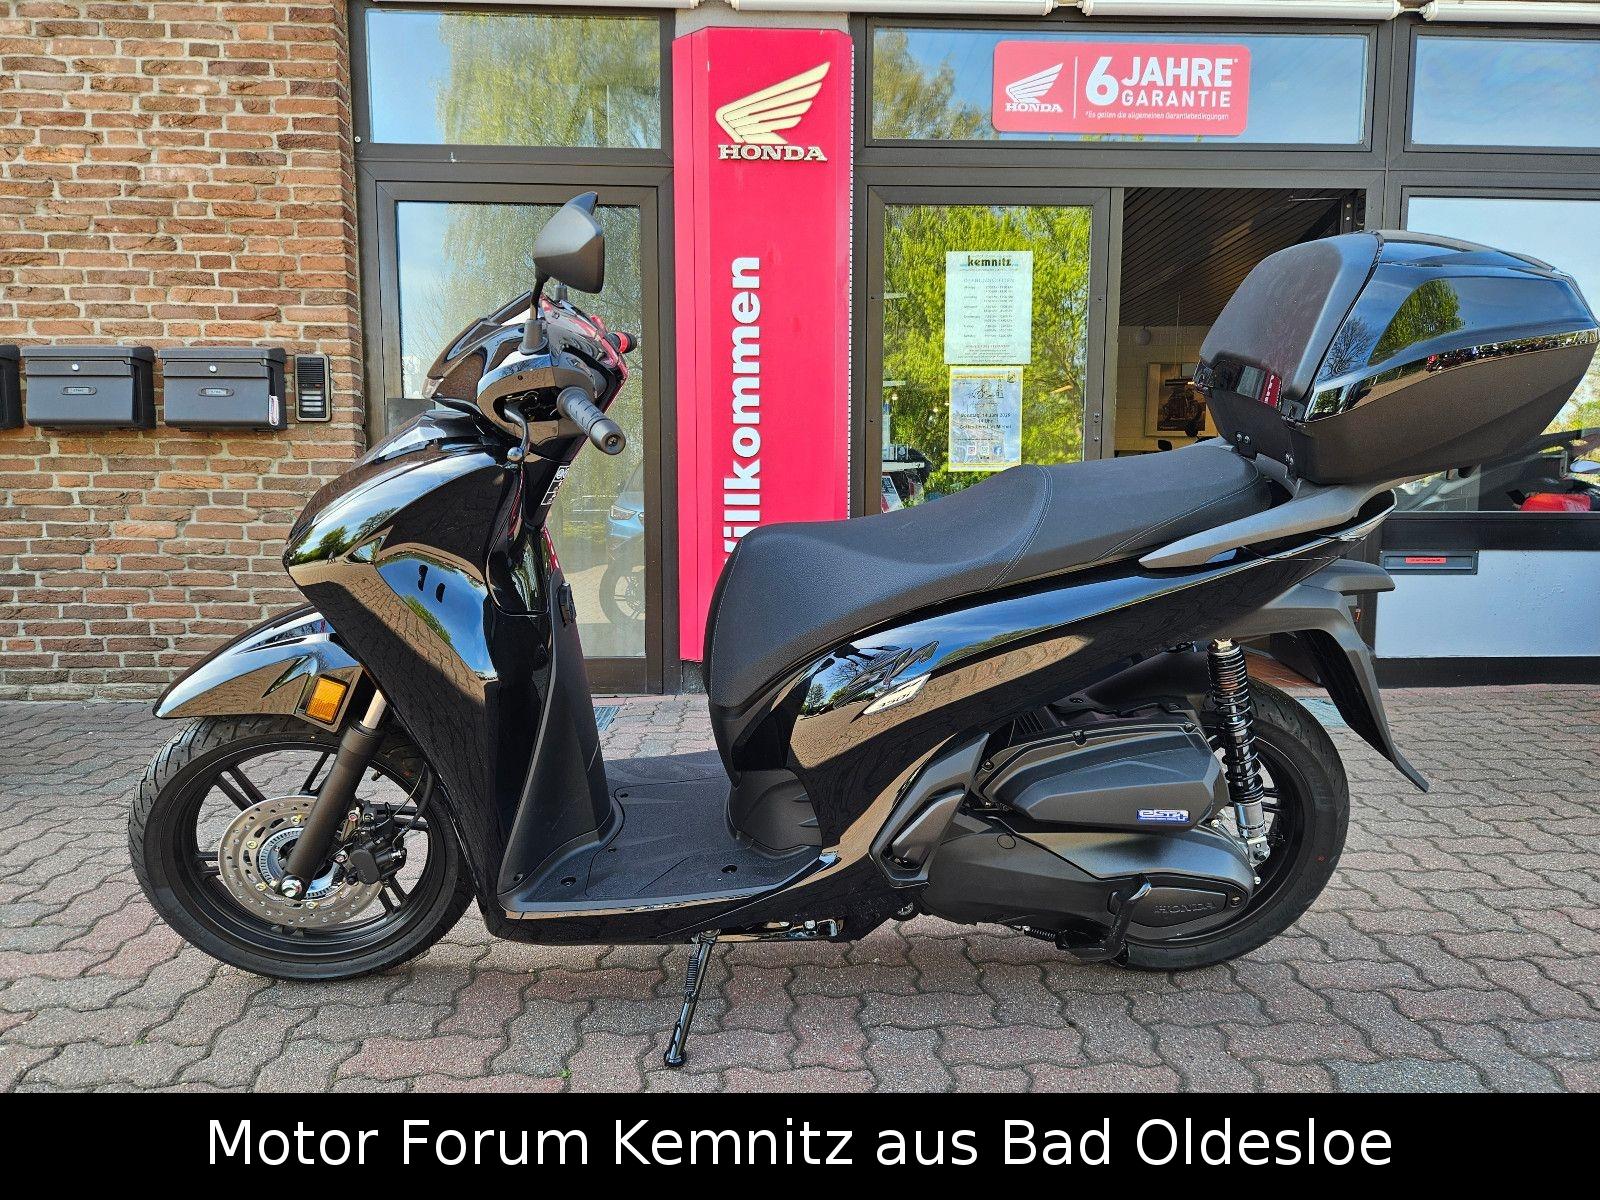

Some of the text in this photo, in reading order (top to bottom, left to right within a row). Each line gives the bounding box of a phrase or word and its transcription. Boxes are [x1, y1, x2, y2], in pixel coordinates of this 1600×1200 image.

[1085, 56, 1119, 106] 6
[1121, 90, 1231, 108] GARANTIE
[1005, 102, 1064, 113] HONDA
[1128, 112, 1165, 121] allgemeinen
[718, 144, 828, 161] HONDA
[967, 255, 1012, 267] kemnitz
[723, 256, 761, 563] illkommen
[1153, 902, 1218, 914] HONDA
